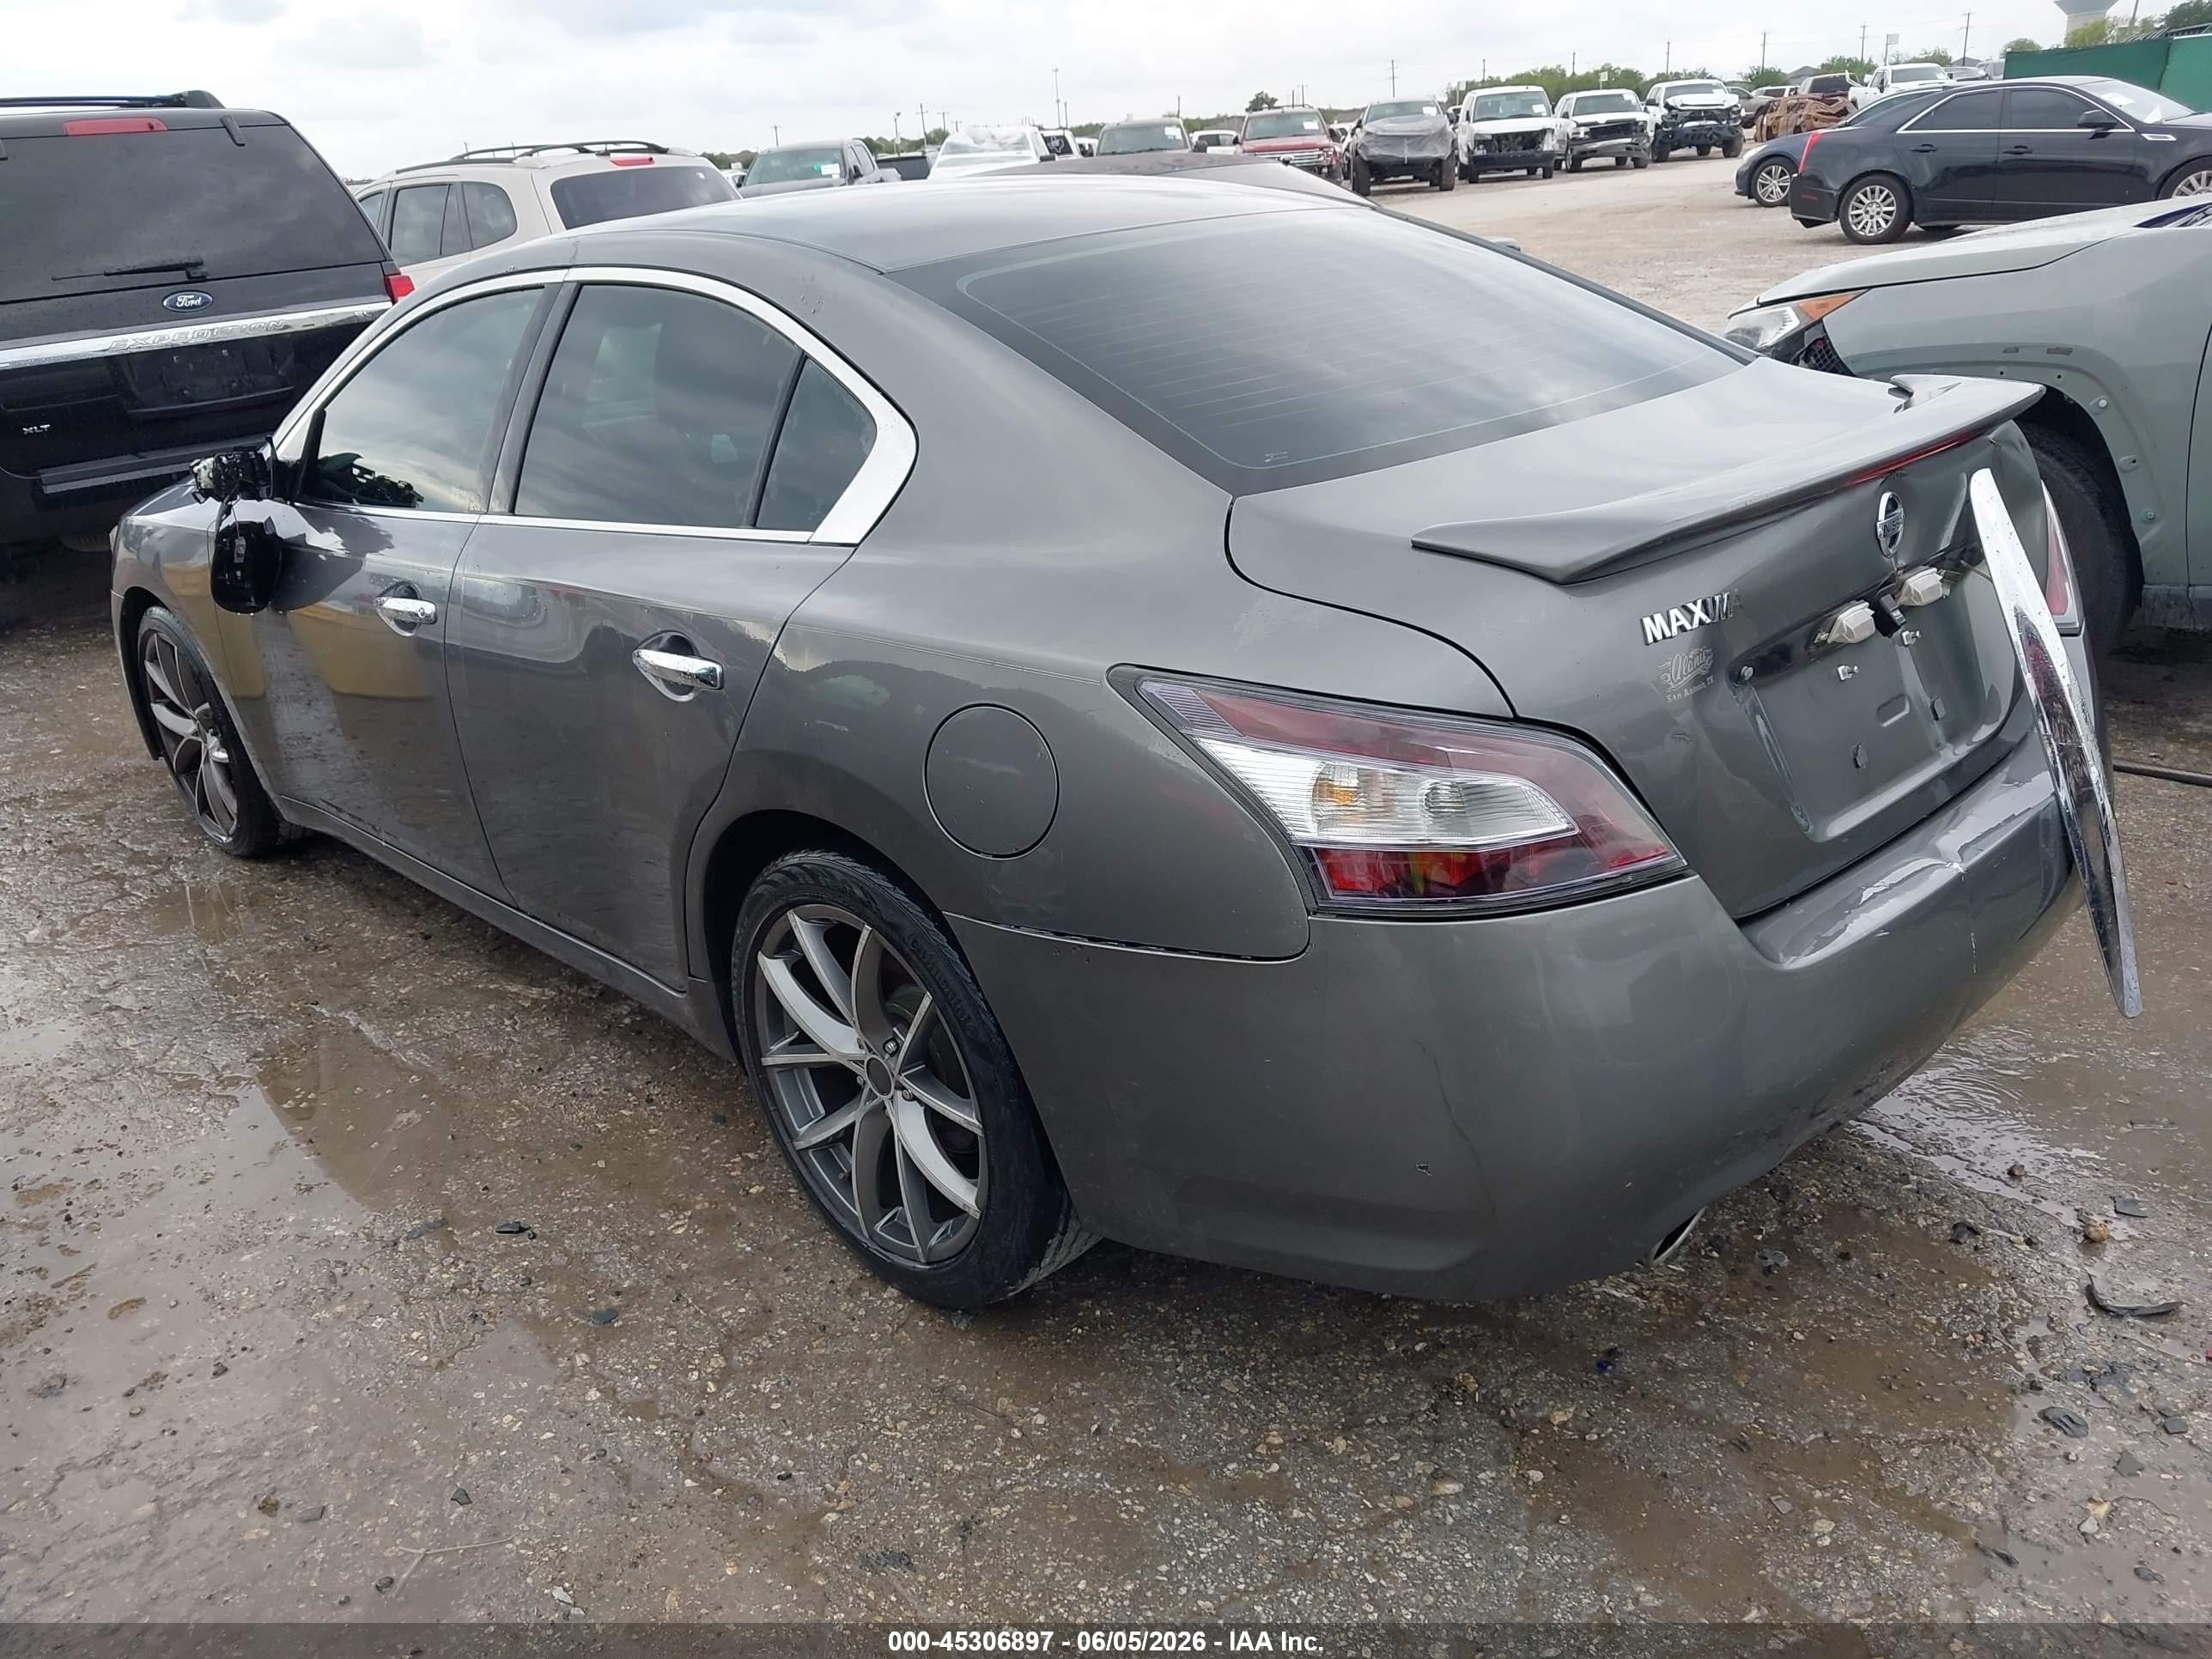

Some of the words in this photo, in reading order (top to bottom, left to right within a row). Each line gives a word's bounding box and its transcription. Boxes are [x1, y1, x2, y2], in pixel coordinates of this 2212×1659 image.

[176, 295, 202, 307] Ford
[109, 319, 284, 350] EXPEDITION
[22, 424, 51, 434] XLT
[1667, 694, 1682, 702] San
